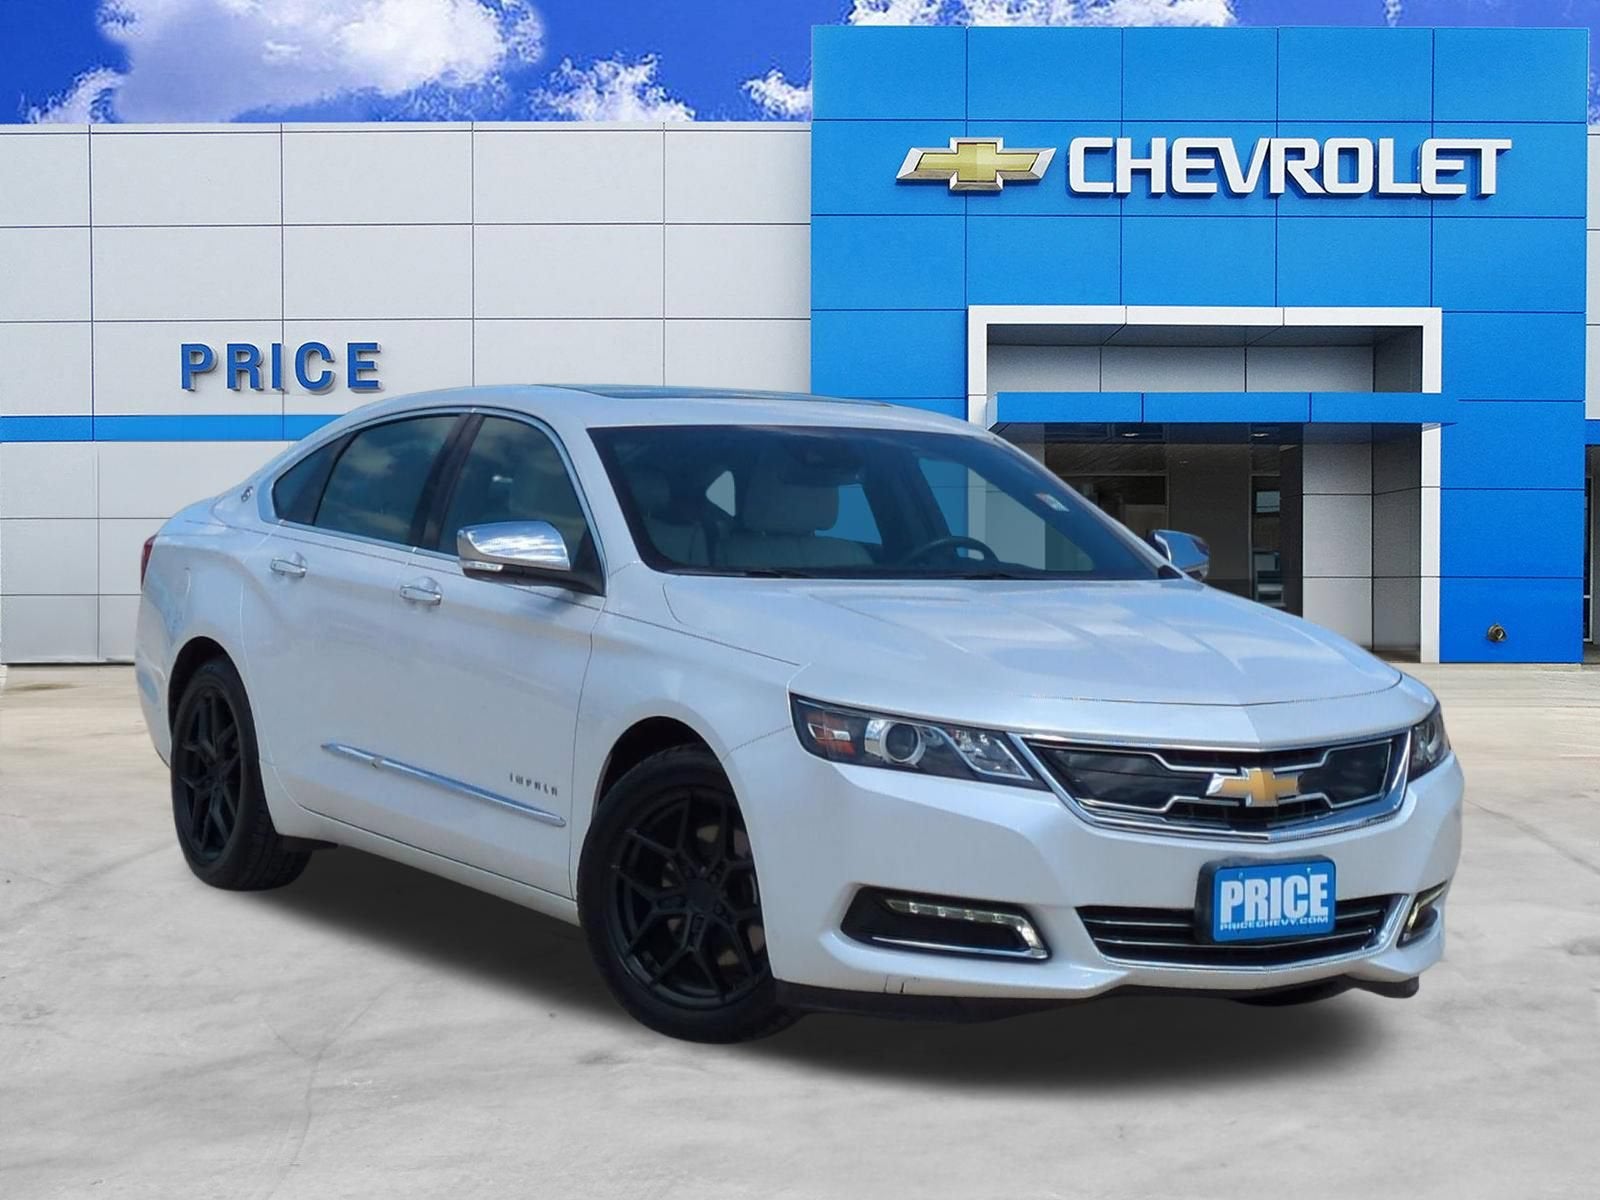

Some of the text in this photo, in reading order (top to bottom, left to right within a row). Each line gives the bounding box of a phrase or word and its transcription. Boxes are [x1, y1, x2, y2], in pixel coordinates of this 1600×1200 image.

[1068, 137, 1513, 196] CHEVROLET
[180, 341, 382, 394] PRICE
[509, 772, 558, 797] IMPALA
[1220, 873, 1329, 922] PRICE
[1220, 916, 1329, 931] PRICECHEVY.COM
